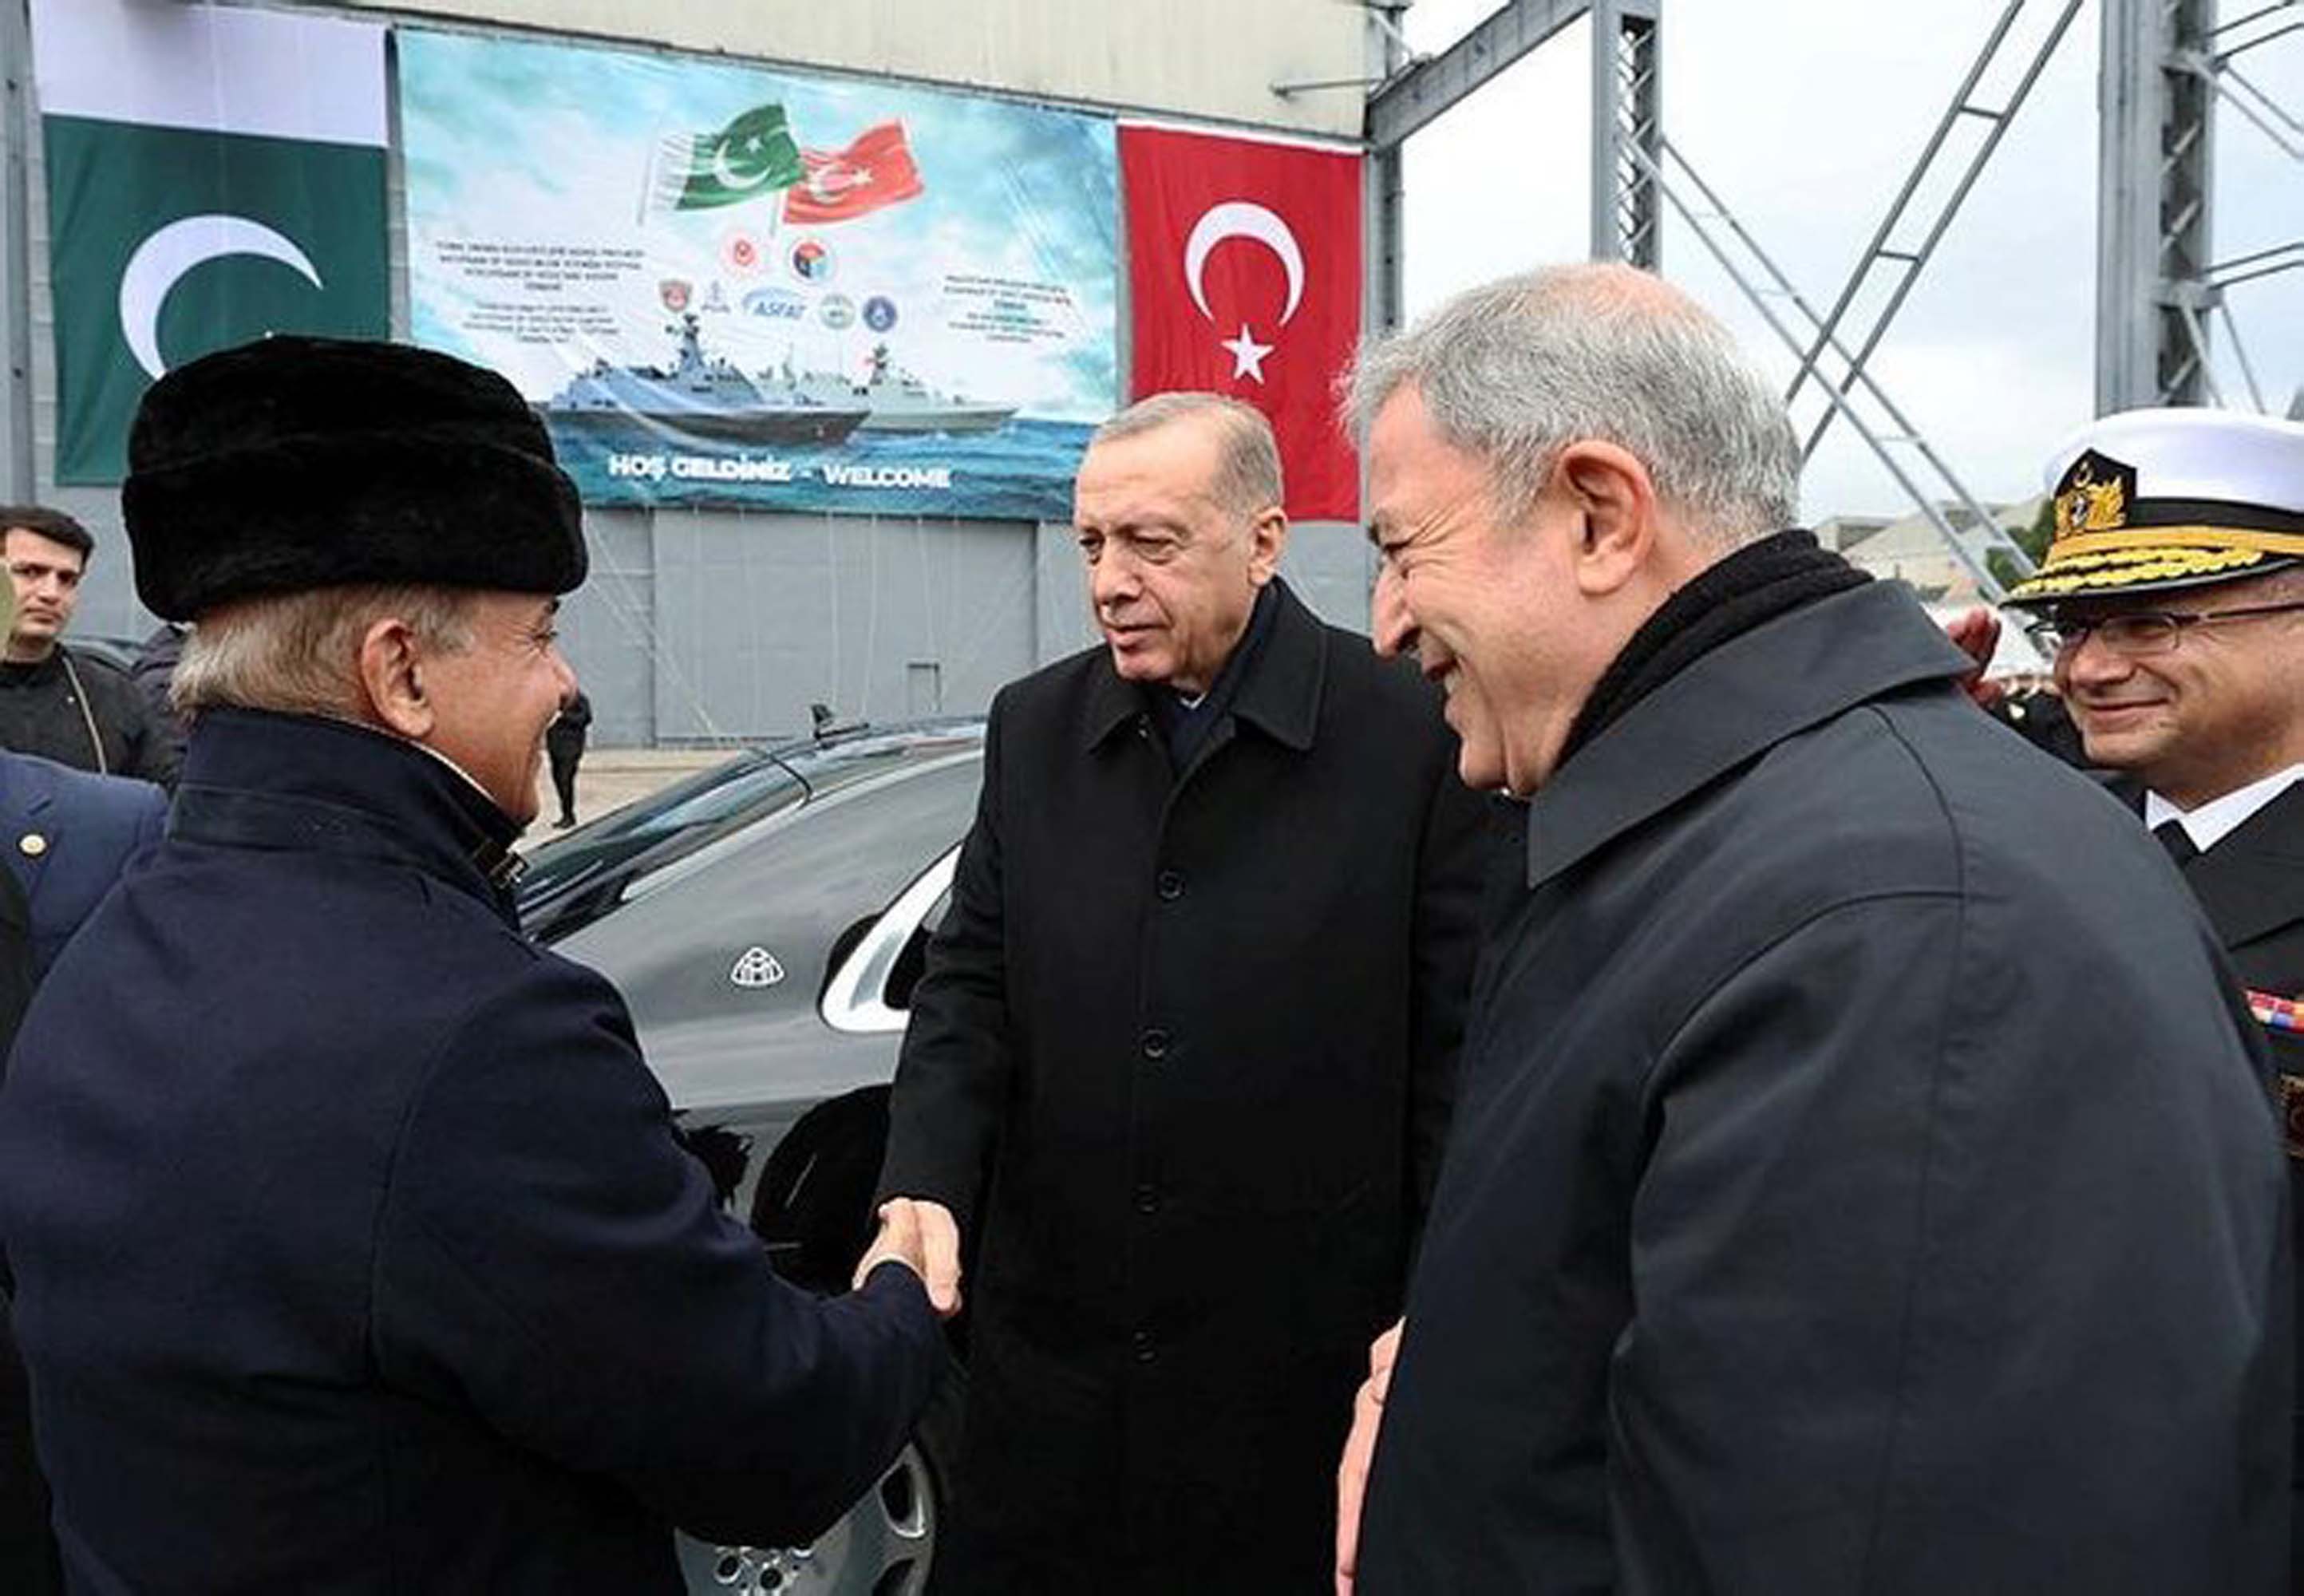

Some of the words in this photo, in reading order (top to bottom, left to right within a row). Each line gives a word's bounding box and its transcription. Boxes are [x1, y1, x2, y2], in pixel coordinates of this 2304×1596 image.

[608, 454, 666, 480] HOŞ
[671, 453, 791, 481] GELDİNİZ
[823, 464, 950, 488] WELCOME
